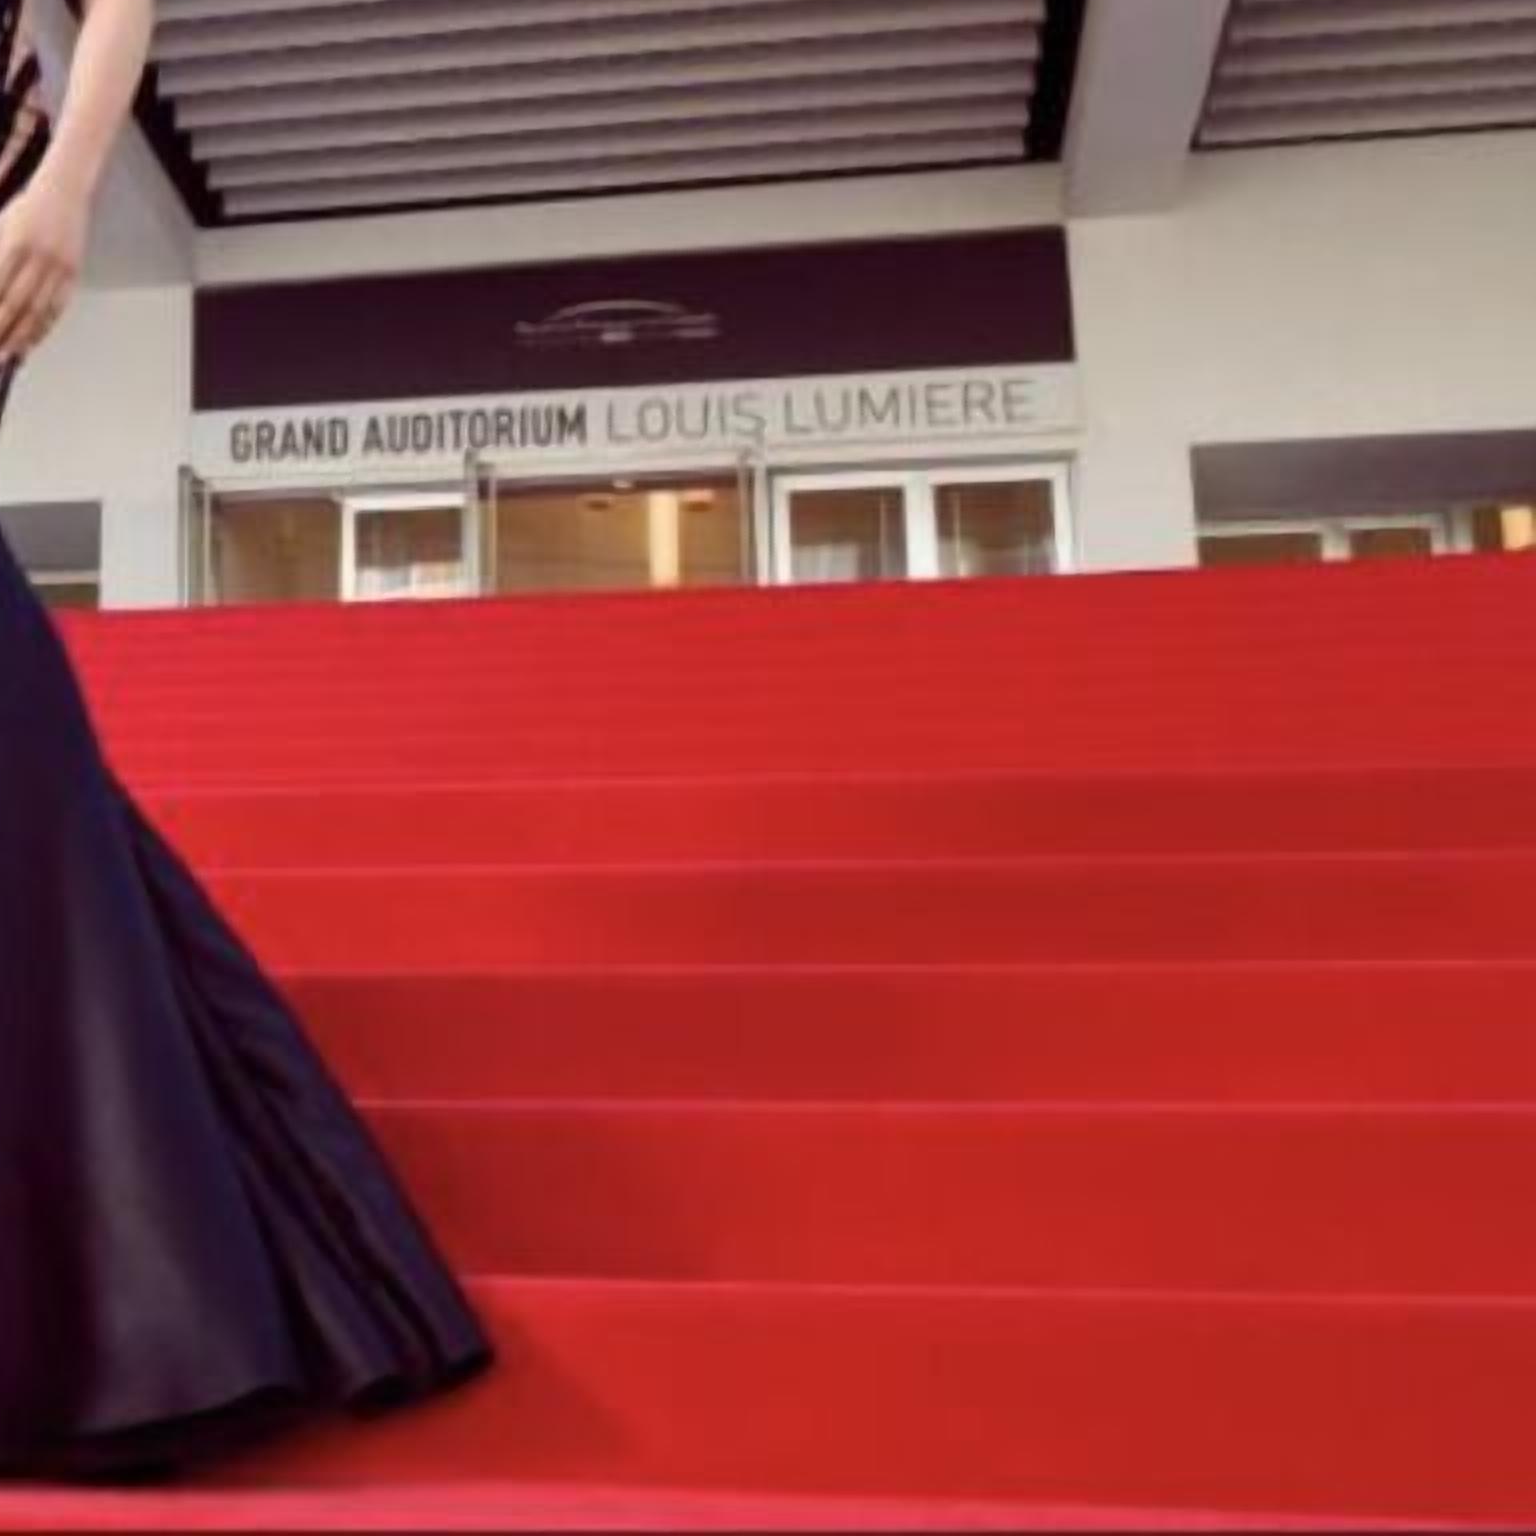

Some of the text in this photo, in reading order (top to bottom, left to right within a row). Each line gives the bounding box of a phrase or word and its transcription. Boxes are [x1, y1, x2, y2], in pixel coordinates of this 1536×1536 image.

[229, 376, 1036, 464] GRAND AUDITORIUM LOUIS LUMIERE
